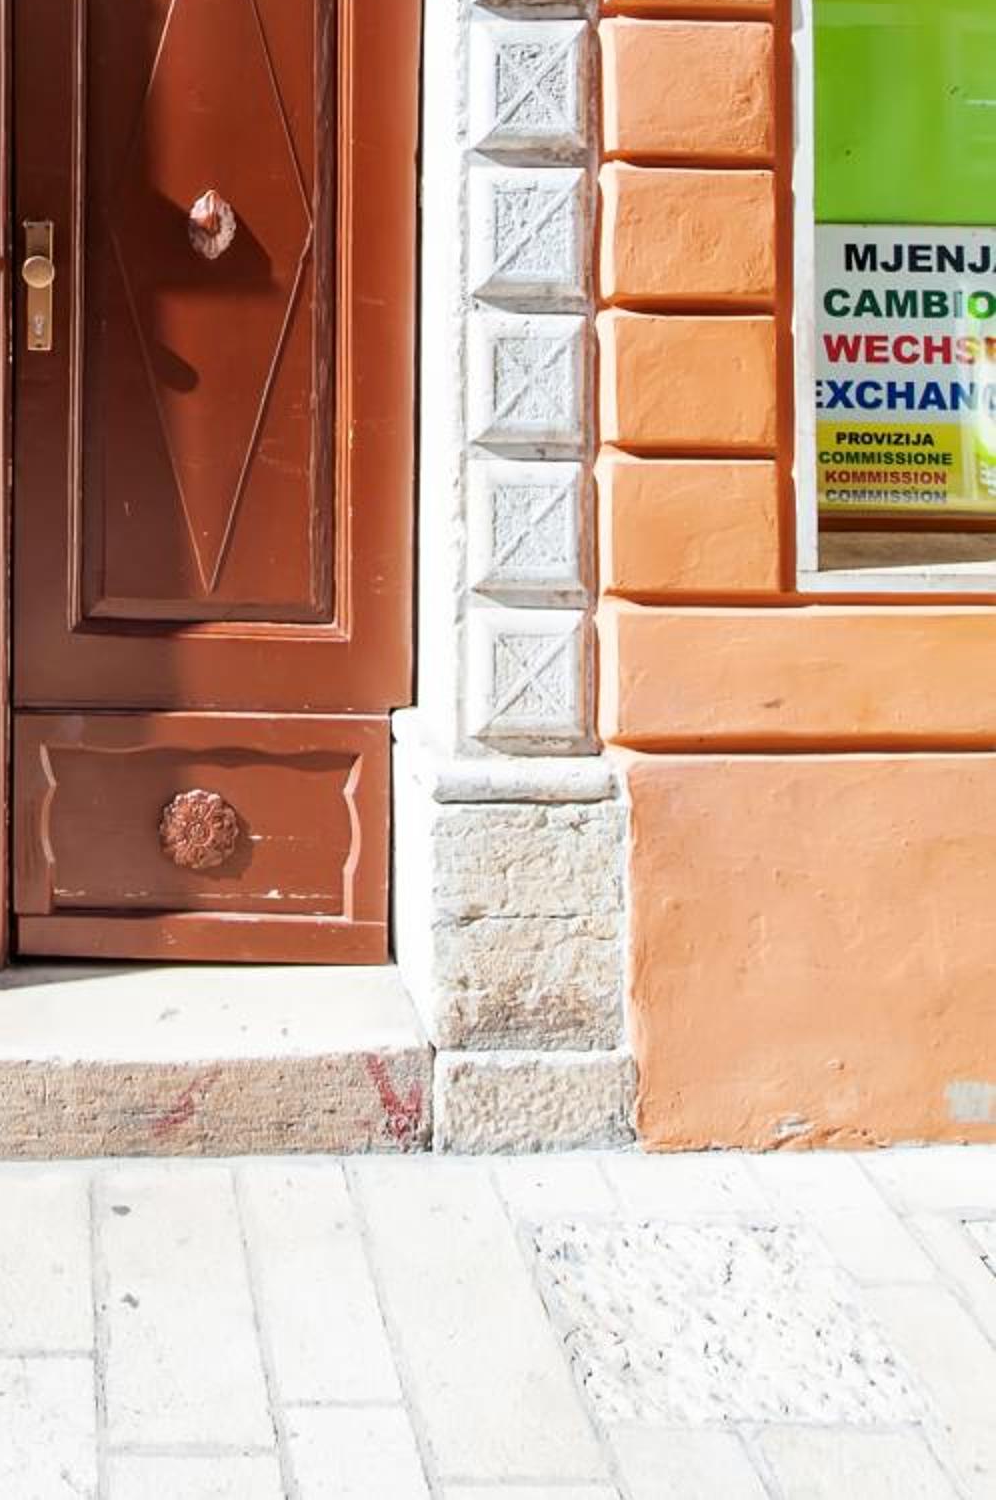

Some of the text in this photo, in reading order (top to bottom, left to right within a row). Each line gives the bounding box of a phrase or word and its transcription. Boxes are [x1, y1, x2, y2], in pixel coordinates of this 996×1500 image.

[845, 243, 996, 273] MJENJ
[823, 288, 996, 319] CAMBIO
[835, 431, 935, 446] PROVIZIJA
[818, 451, 954, 466] COMMISSIONE
[825, 470, 947, 485] KOMMISSION
[825, 488, 948, 503] COMMISSION
